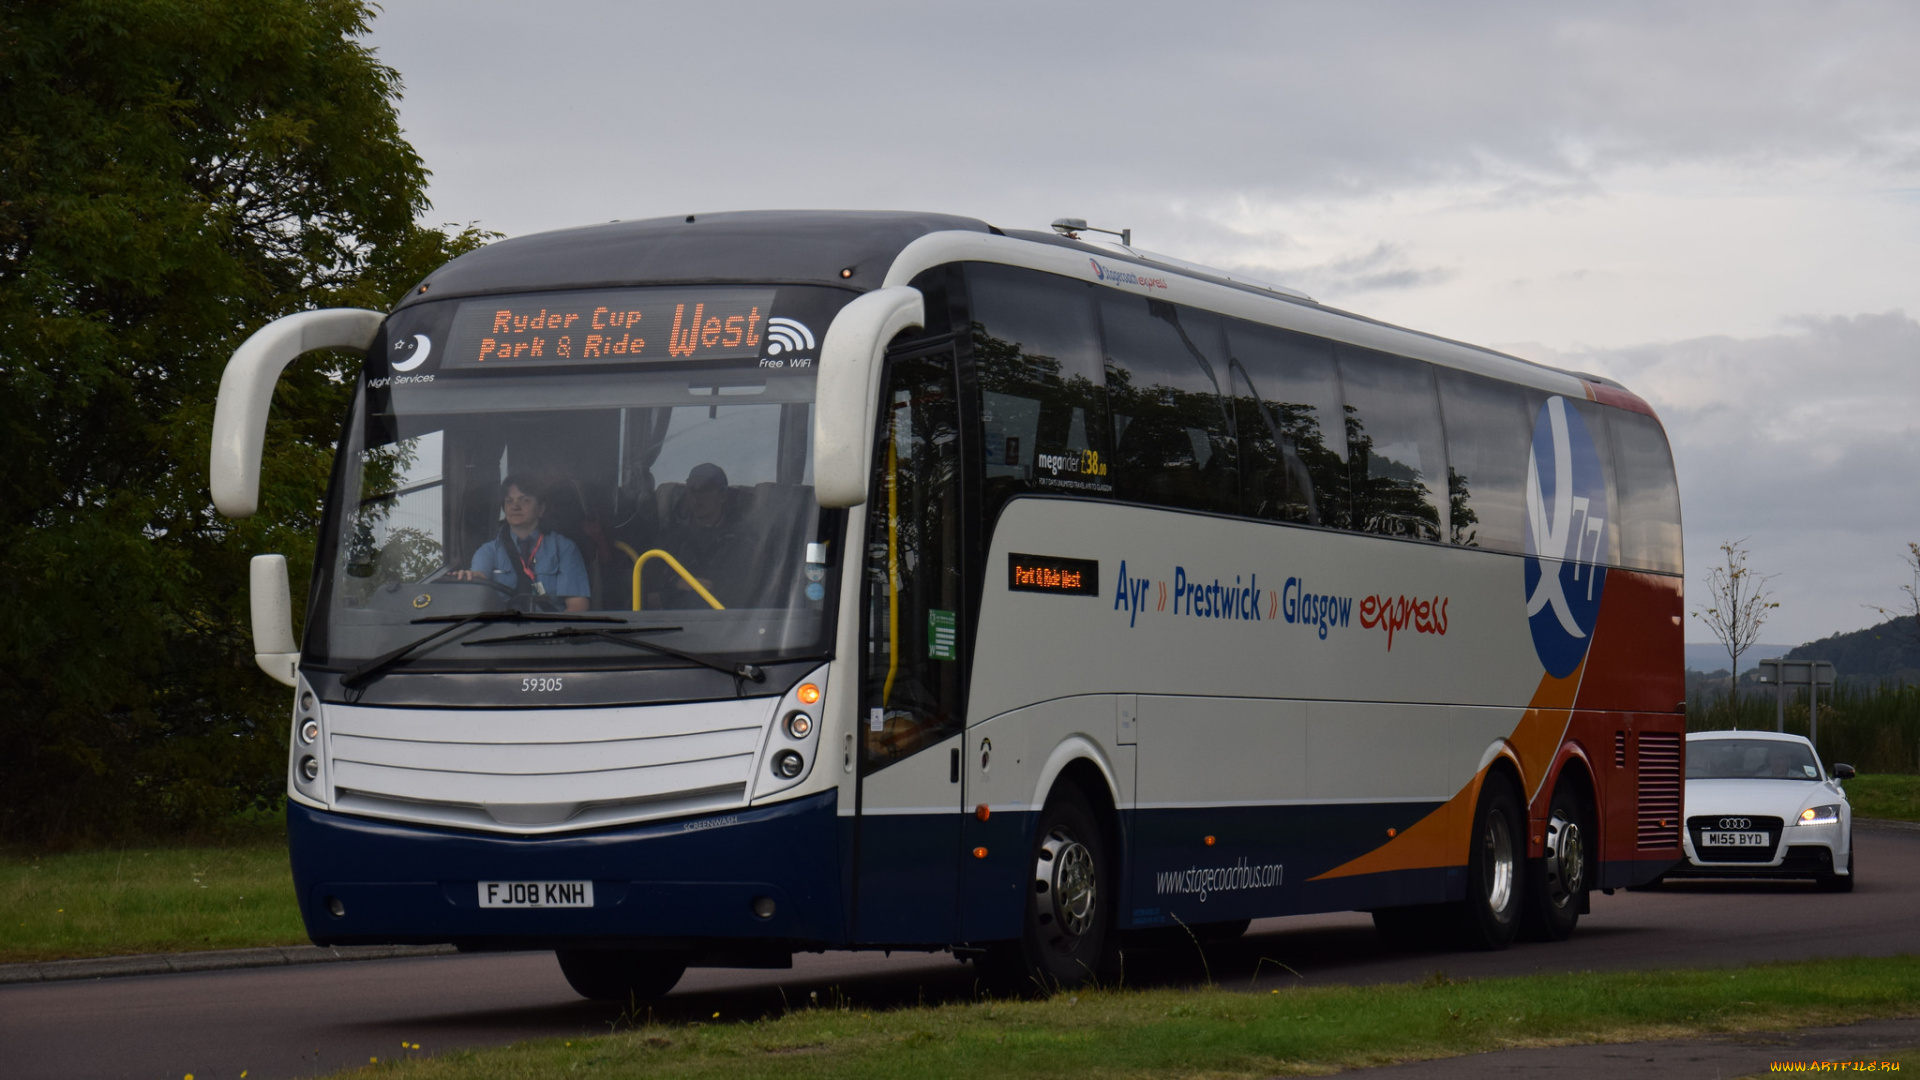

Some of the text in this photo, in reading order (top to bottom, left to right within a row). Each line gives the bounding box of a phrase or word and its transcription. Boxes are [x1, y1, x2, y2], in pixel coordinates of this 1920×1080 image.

[1138, 275, 1168, 292] express
[493, 306, 642, 334] Ryder Cup
[668, 303, 761, 357] West
[478, 333, 646, 361] Park & Ride
[759, 357, 812, 368] Free WiFi
[367, 373, 435, 389] Night Services
[1038, 453, 1080, 475] megarider
[1015, 565, 1035, 585] Park
[1043, 568, 1061, 587] Ride
[1061, 569, 1081, 589] West
[1114, 559, 1449, 653] Ayr Prestwick Glasgow express
[521, 677, 563, 692] 59305
[683, 816, 738, 832] SCREENWASH
[1739, 834, 1762, 845] BYD
[1156, 856, 1283, 902] www.stagecoachbus.com
[487, 882, 585, 905] FJ08 KNH
